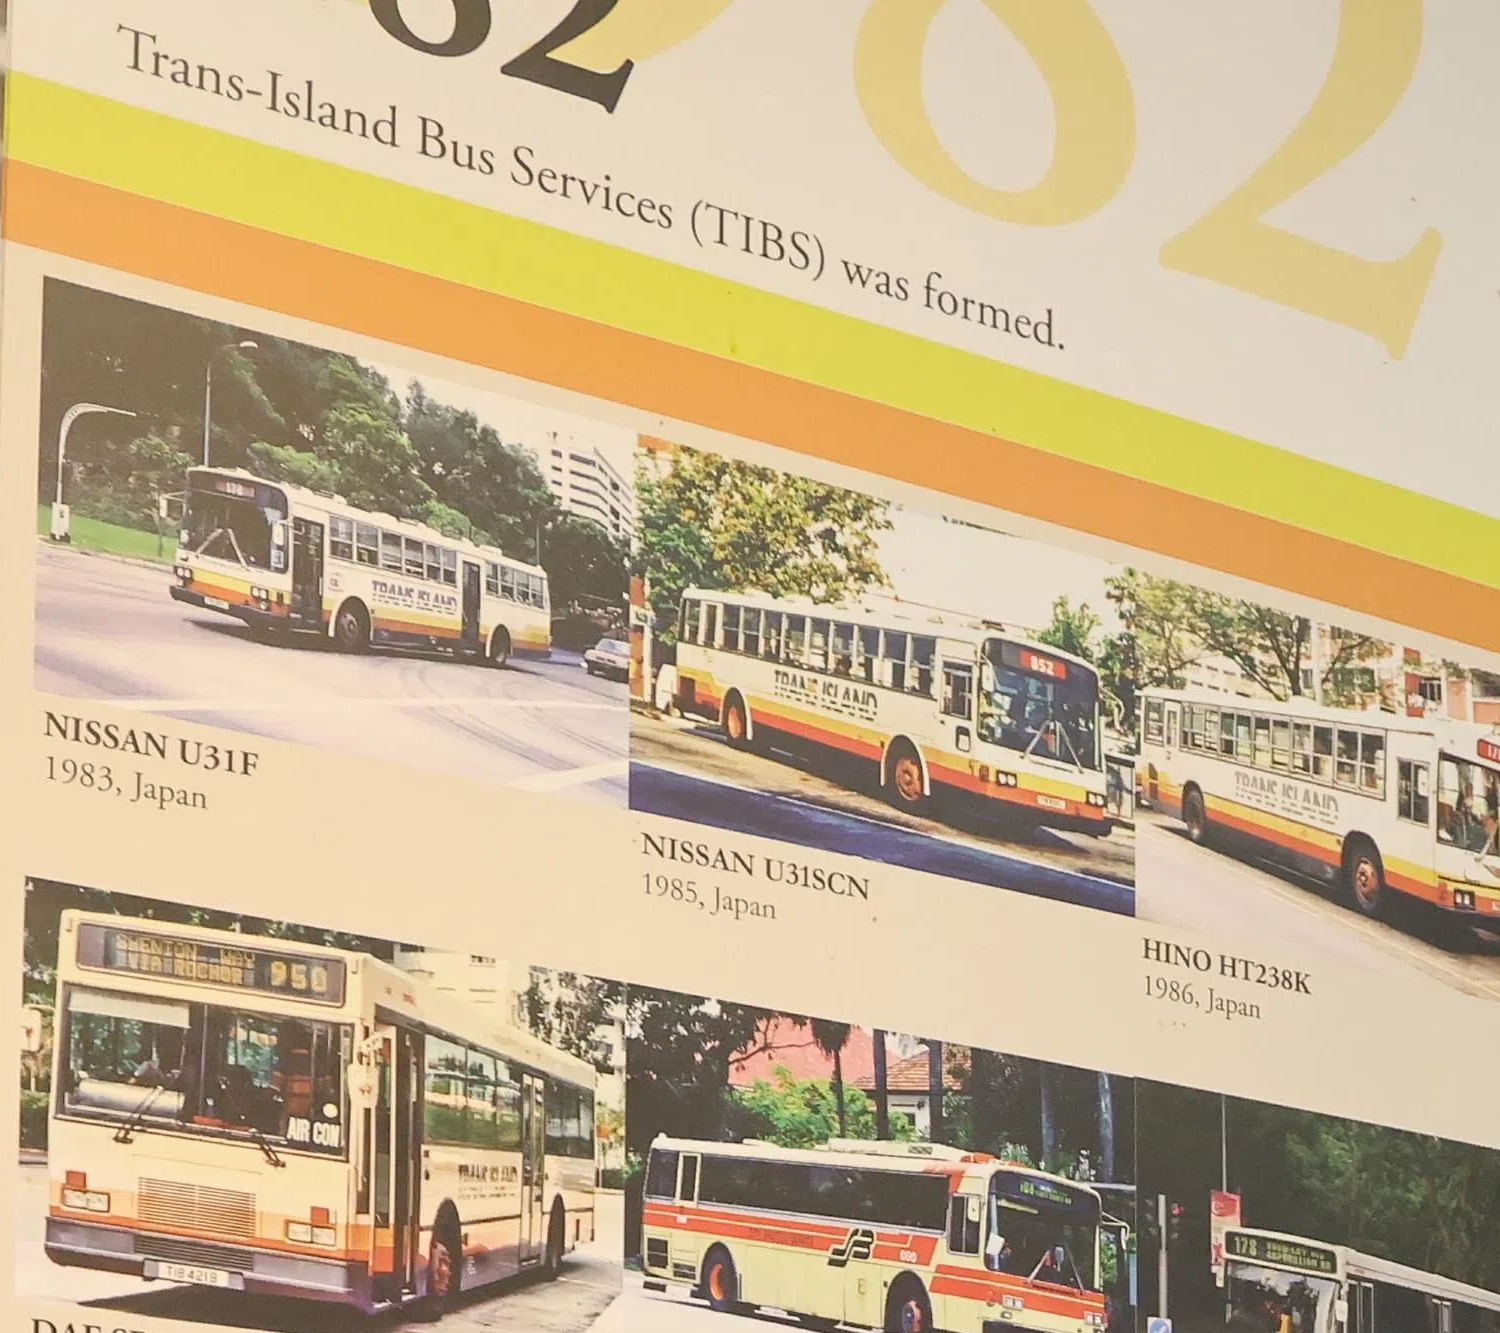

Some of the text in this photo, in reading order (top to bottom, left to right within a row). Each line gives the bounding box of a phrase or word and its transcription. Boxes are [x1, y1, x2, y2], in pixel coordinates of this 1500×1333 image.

[116, 22, 1066, 352] Trans-Island Bus Services (TIBS) was formed.
[44, 710, 260, 778] NISSAN U31F
[45, 753, 209, 813] 1983, Japan
[640, 832, 871, 902] NISSAN U31SCN
[641, 871, 777, 924] 1985, Japan
[1141, 937, 1313, 996] HINO HT238K
[1144, 975, 1262, 1022] 1986, Japan
[286, 1117, 341, 1149] AIR CON
